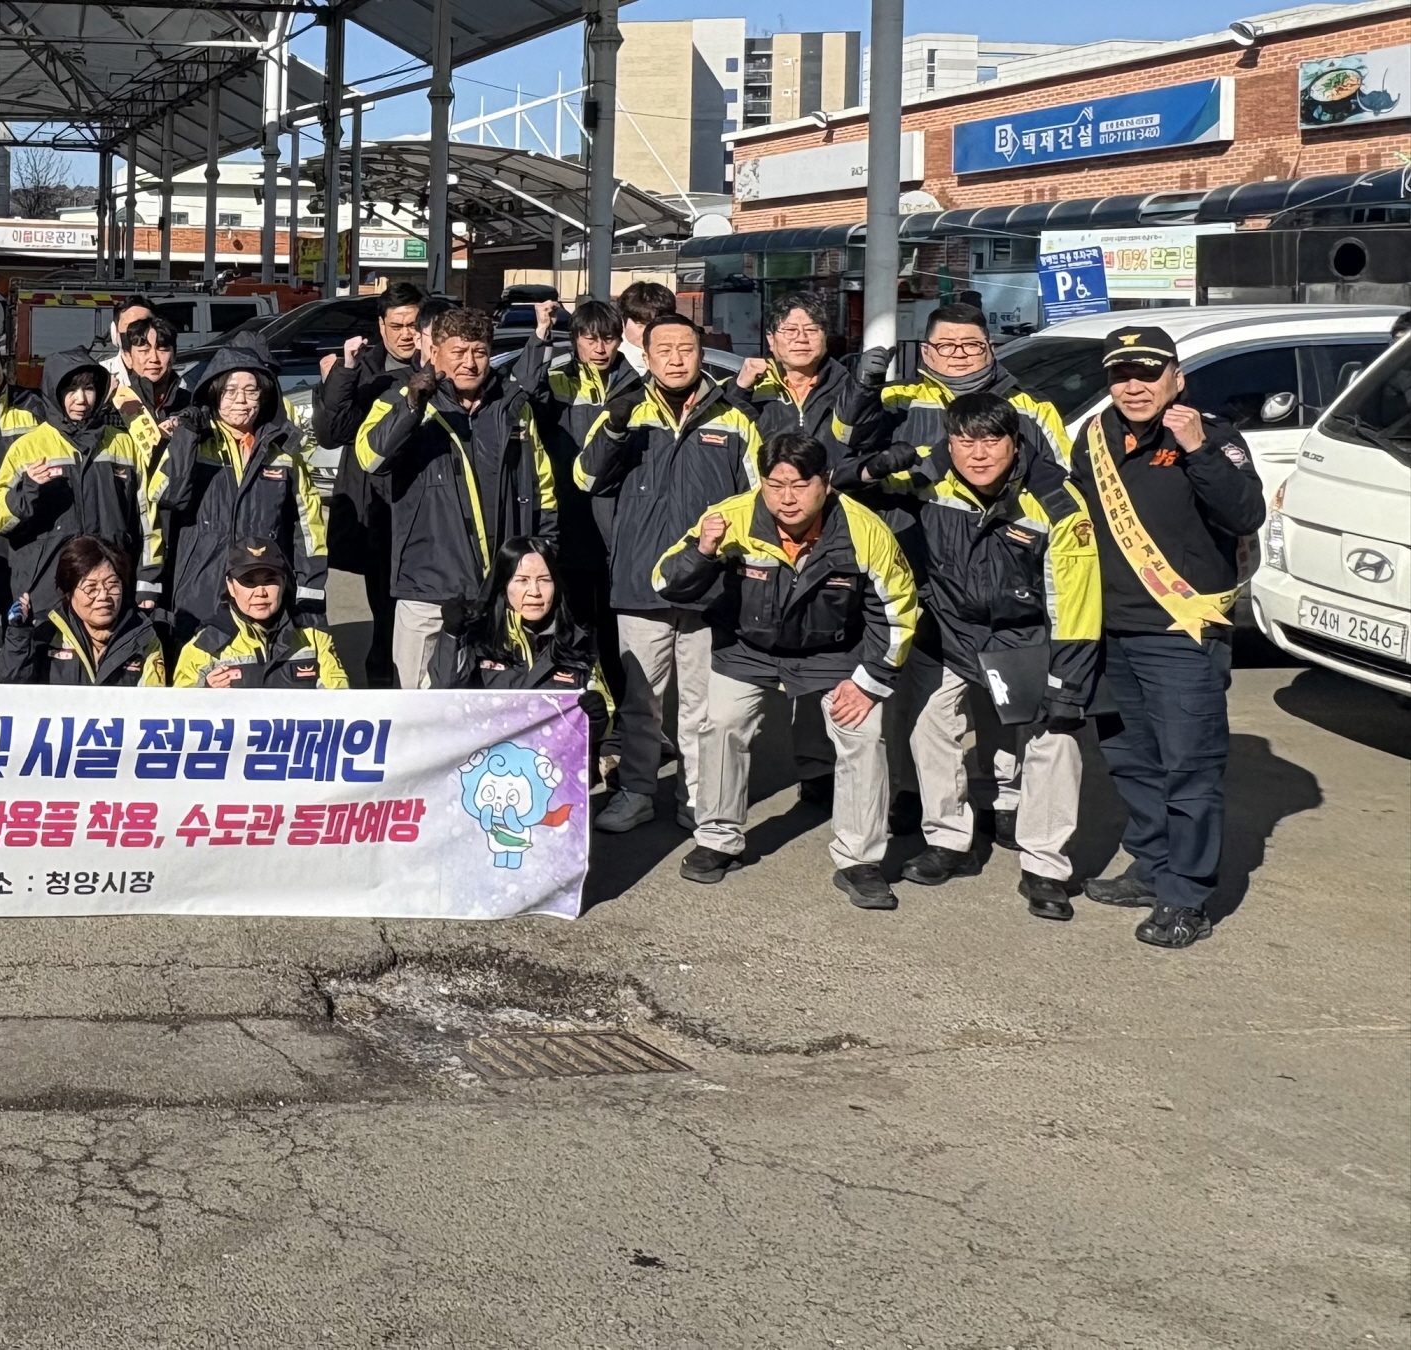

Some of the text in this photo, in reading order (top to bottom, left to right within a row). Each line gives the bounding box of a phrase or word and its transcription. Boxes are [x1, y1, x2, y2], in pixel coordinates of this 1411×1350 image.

[1117, 248, 1148, 271] 10%
[1055, 271, 1073, 301] P
[1310, 605, 1393, 649] 94어 2546
[19, 717, 125, 779] 시설
[135, 719, 235, 780] 점검
[243, 719, 392, 783] 캠페인
[87, 801, 165, 849] 착용,
[176, 804, 285, 847] 수도관
[287, 799, 427, 847] 동파예방
[45, 871, 156, 895] 청양시장
